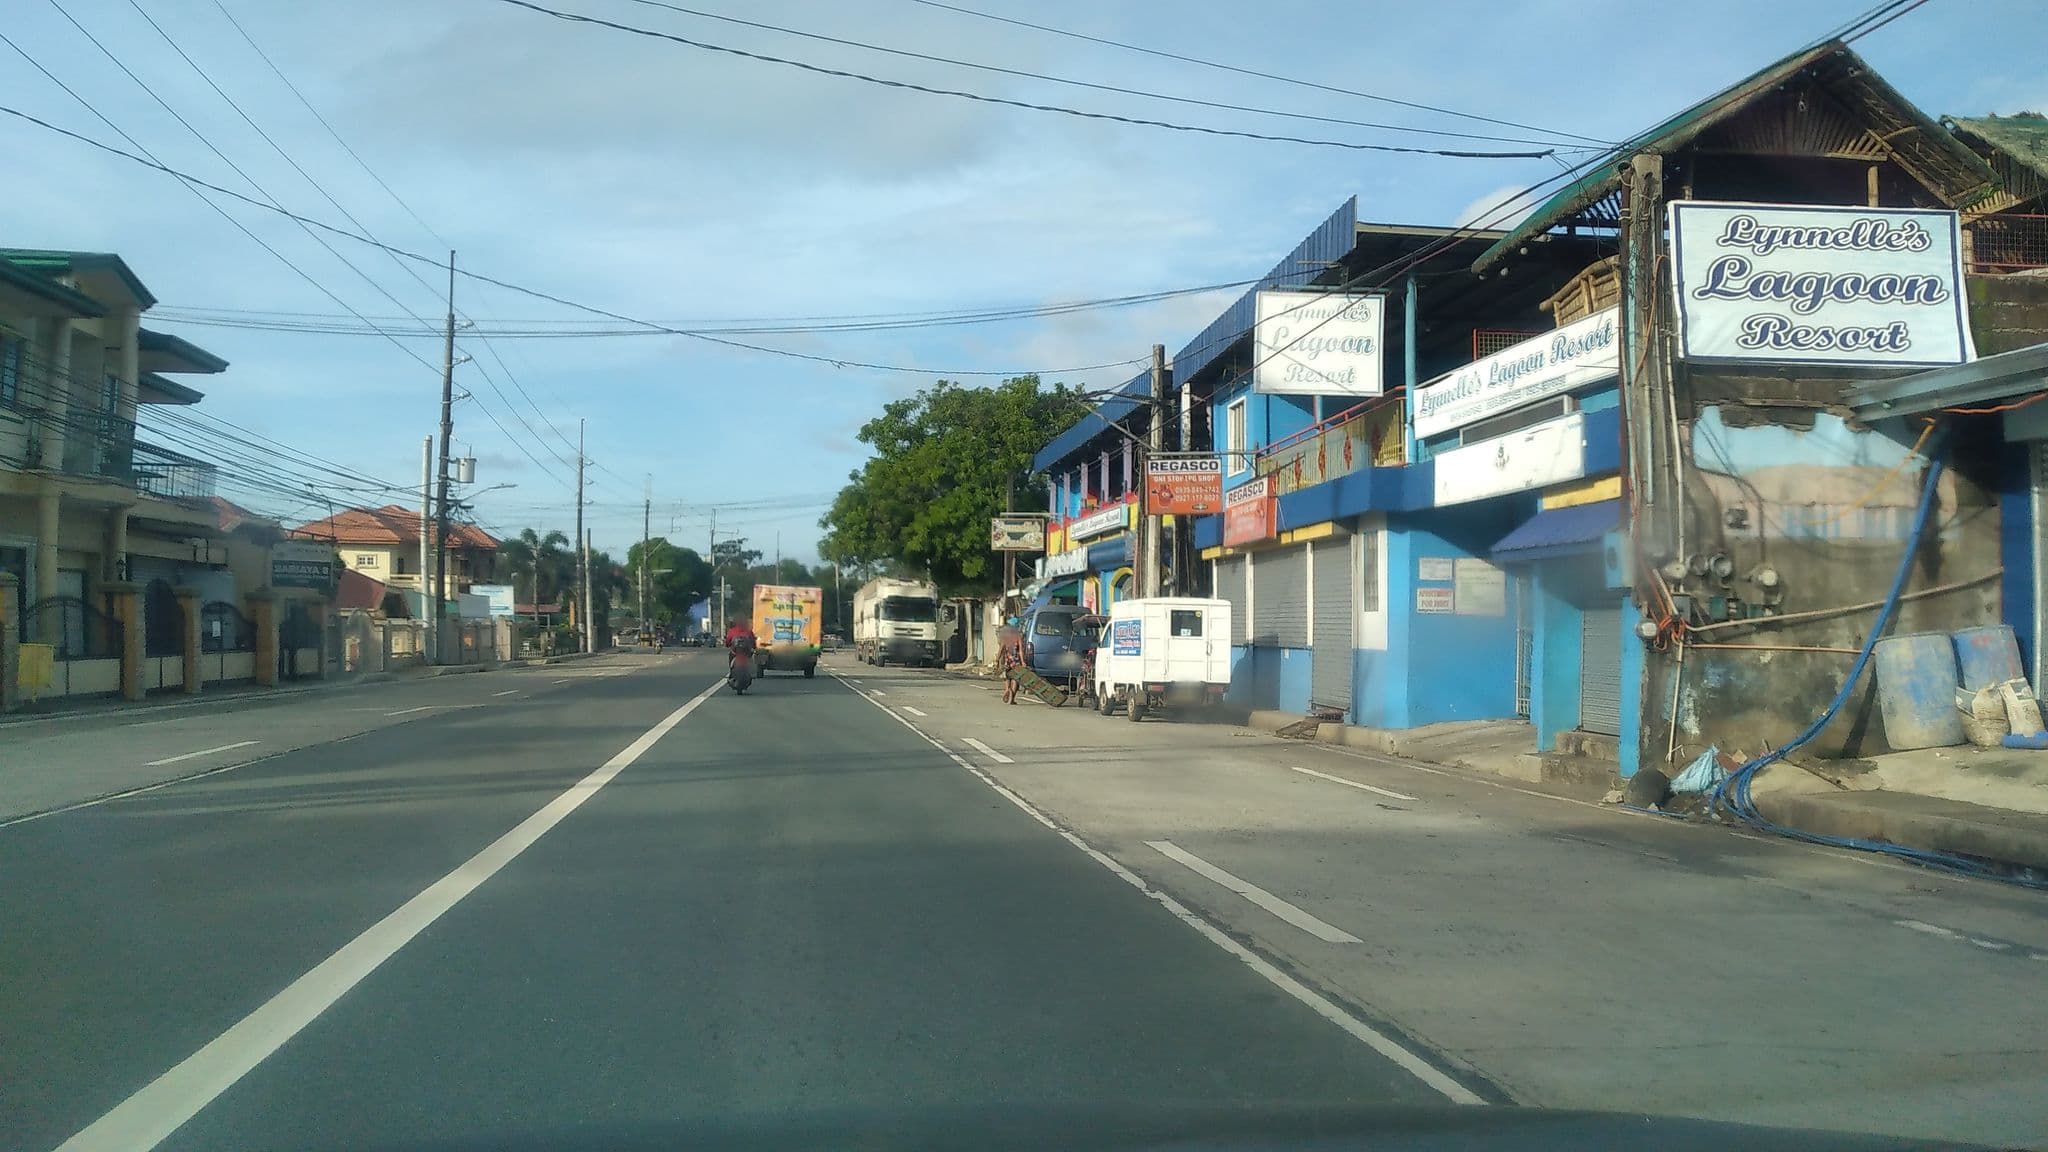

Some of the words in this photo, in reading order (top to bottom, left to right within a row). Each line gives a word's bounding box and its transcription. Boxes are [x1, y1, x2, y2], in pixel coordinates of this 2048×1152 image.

[1718, 215, 1931, 255] Lynnelle's
[1694, 255, 1949, 313] Lagoon
[1266, 326, 1376, 361] Lagoon
[1737, 314, 1911, 351] Resort
[1487, 350, 1546, 389] Lagoon
[1550, 318, 1615, 366] Resort
[1284, 363, 1357, 384] Resort
[1150, 461, 1219, 471] REGASCO
[1228, 481, 1264, 504] REGASCO
